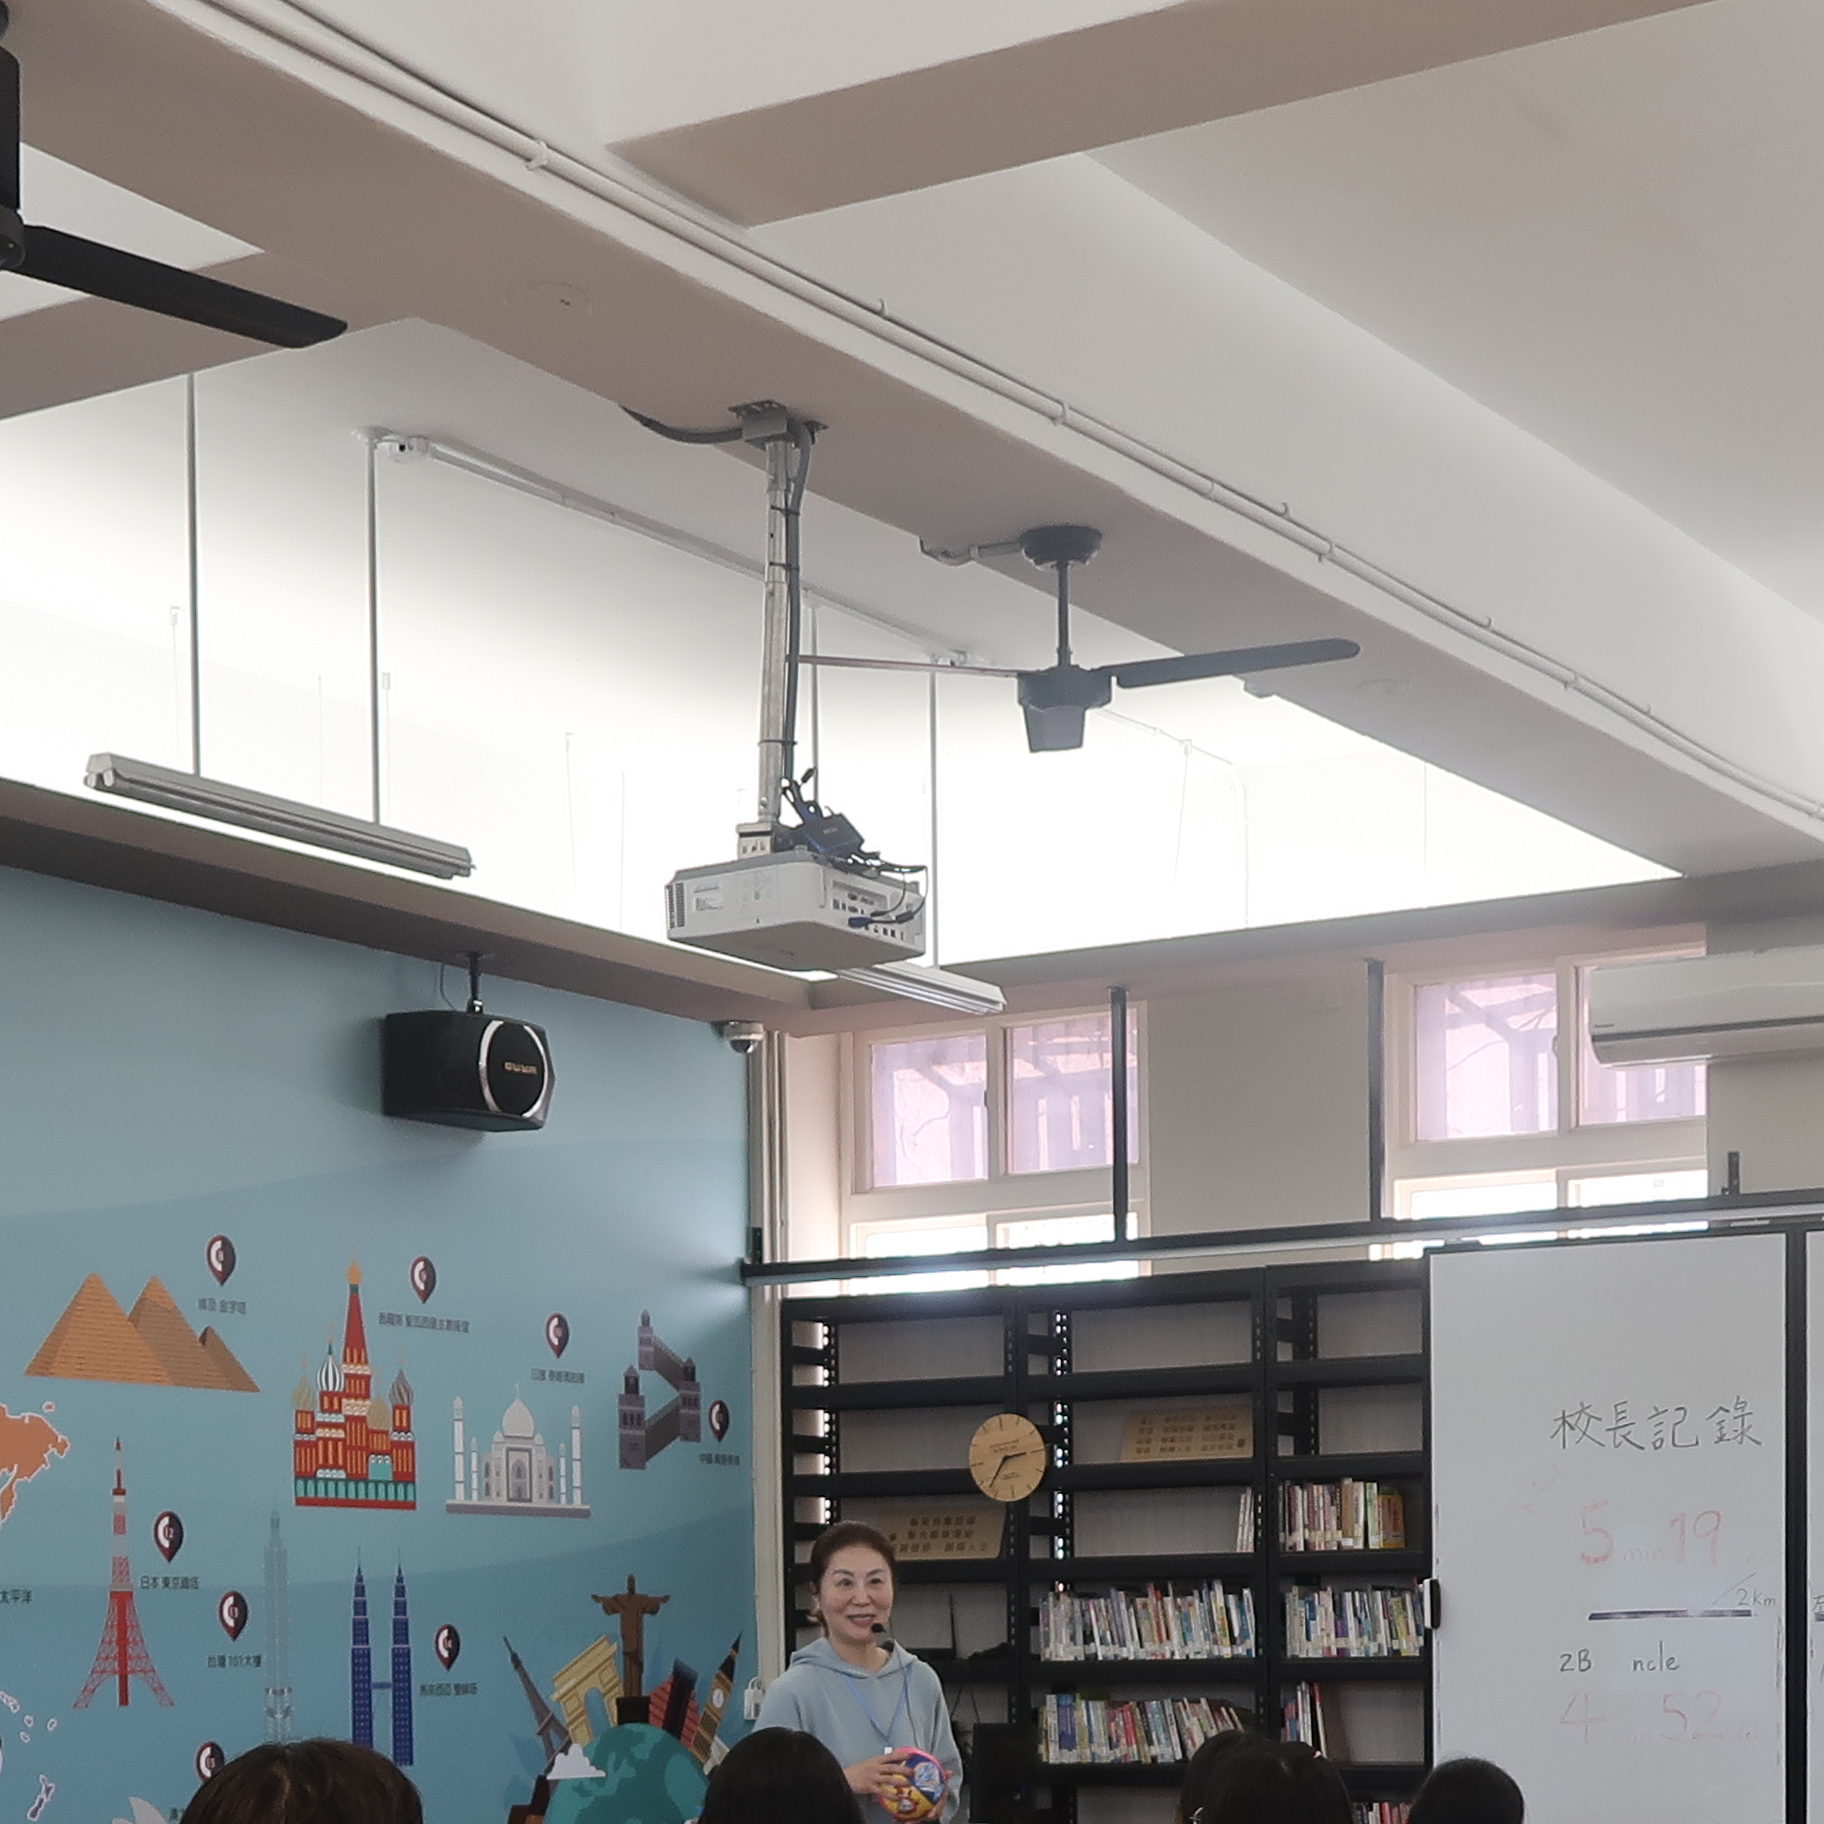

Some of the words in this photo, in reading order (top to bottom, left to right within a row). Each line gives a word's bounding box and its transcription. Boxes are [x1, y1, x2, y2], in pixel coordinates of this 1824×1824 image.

[1551, 1396, 1763, 1452] 校長記錄
[140, 1576, 160, 1590] 日本
